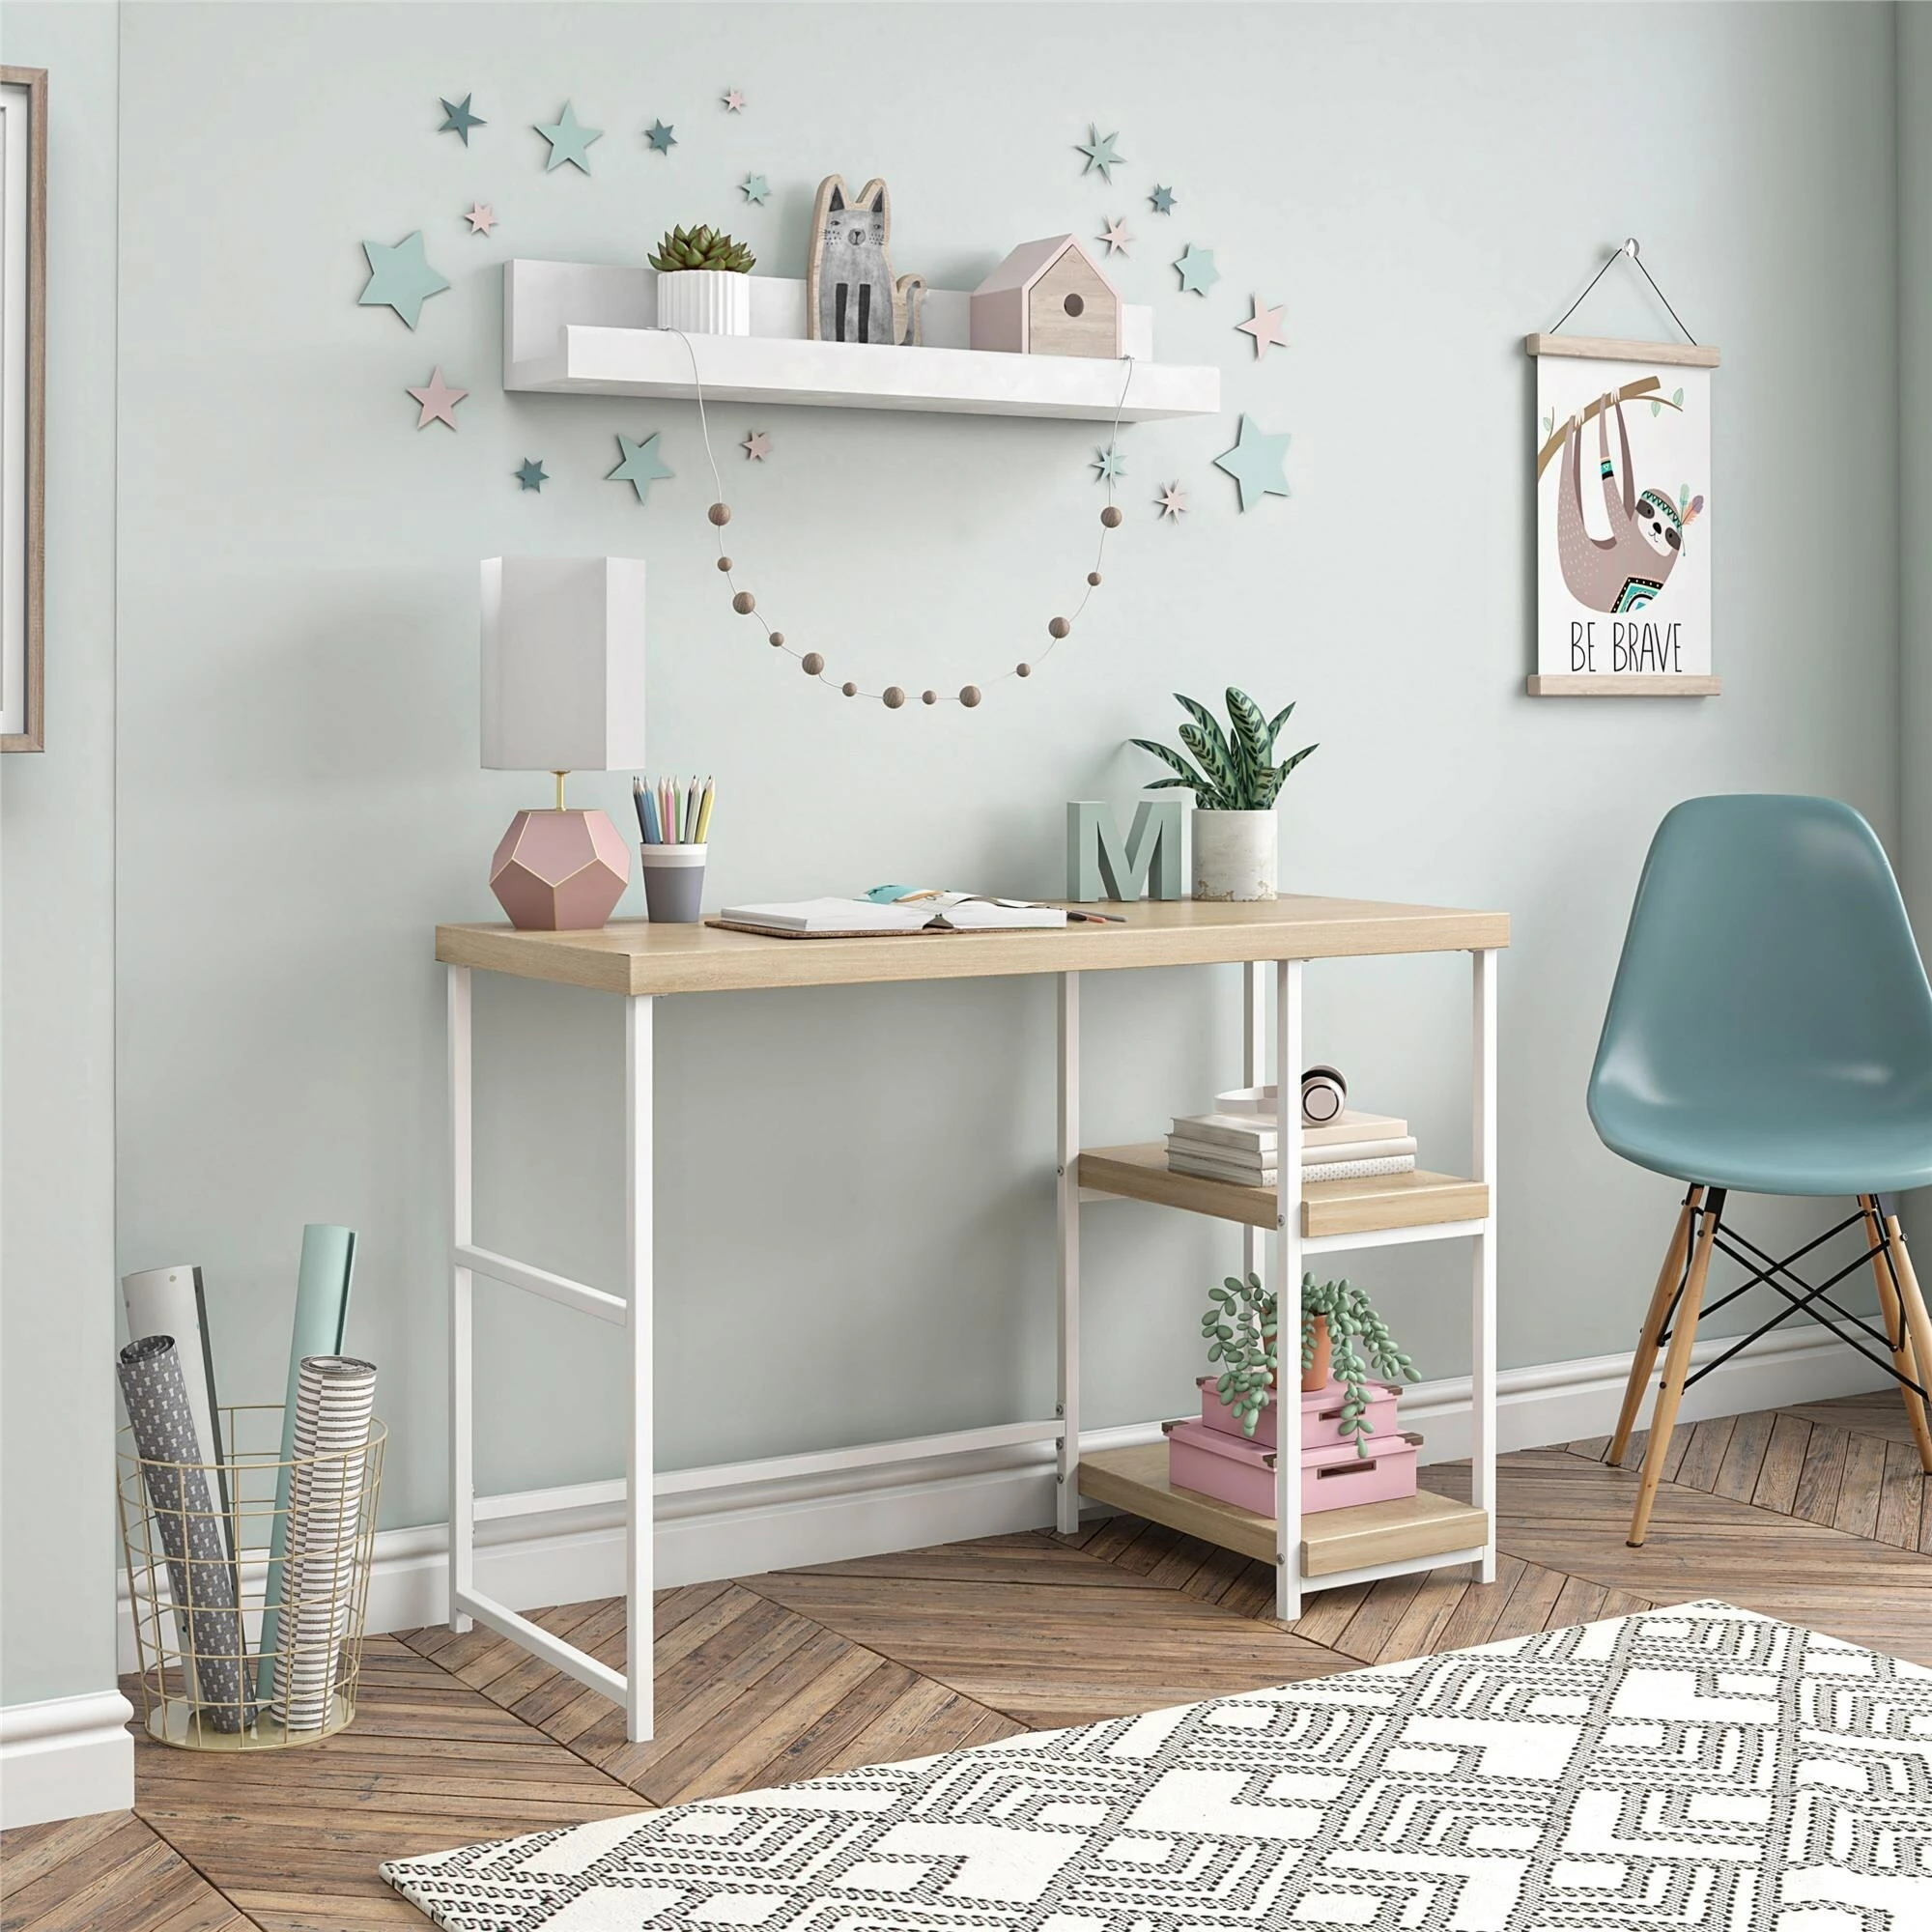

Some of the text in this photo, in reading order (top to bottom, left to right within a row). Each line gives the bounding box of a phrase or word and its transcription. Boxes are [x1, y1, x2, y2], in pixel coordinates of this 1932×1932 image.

[1571, 621, 1683, 673] BE BRAVE
[1066, 801, 1182, 902] M
